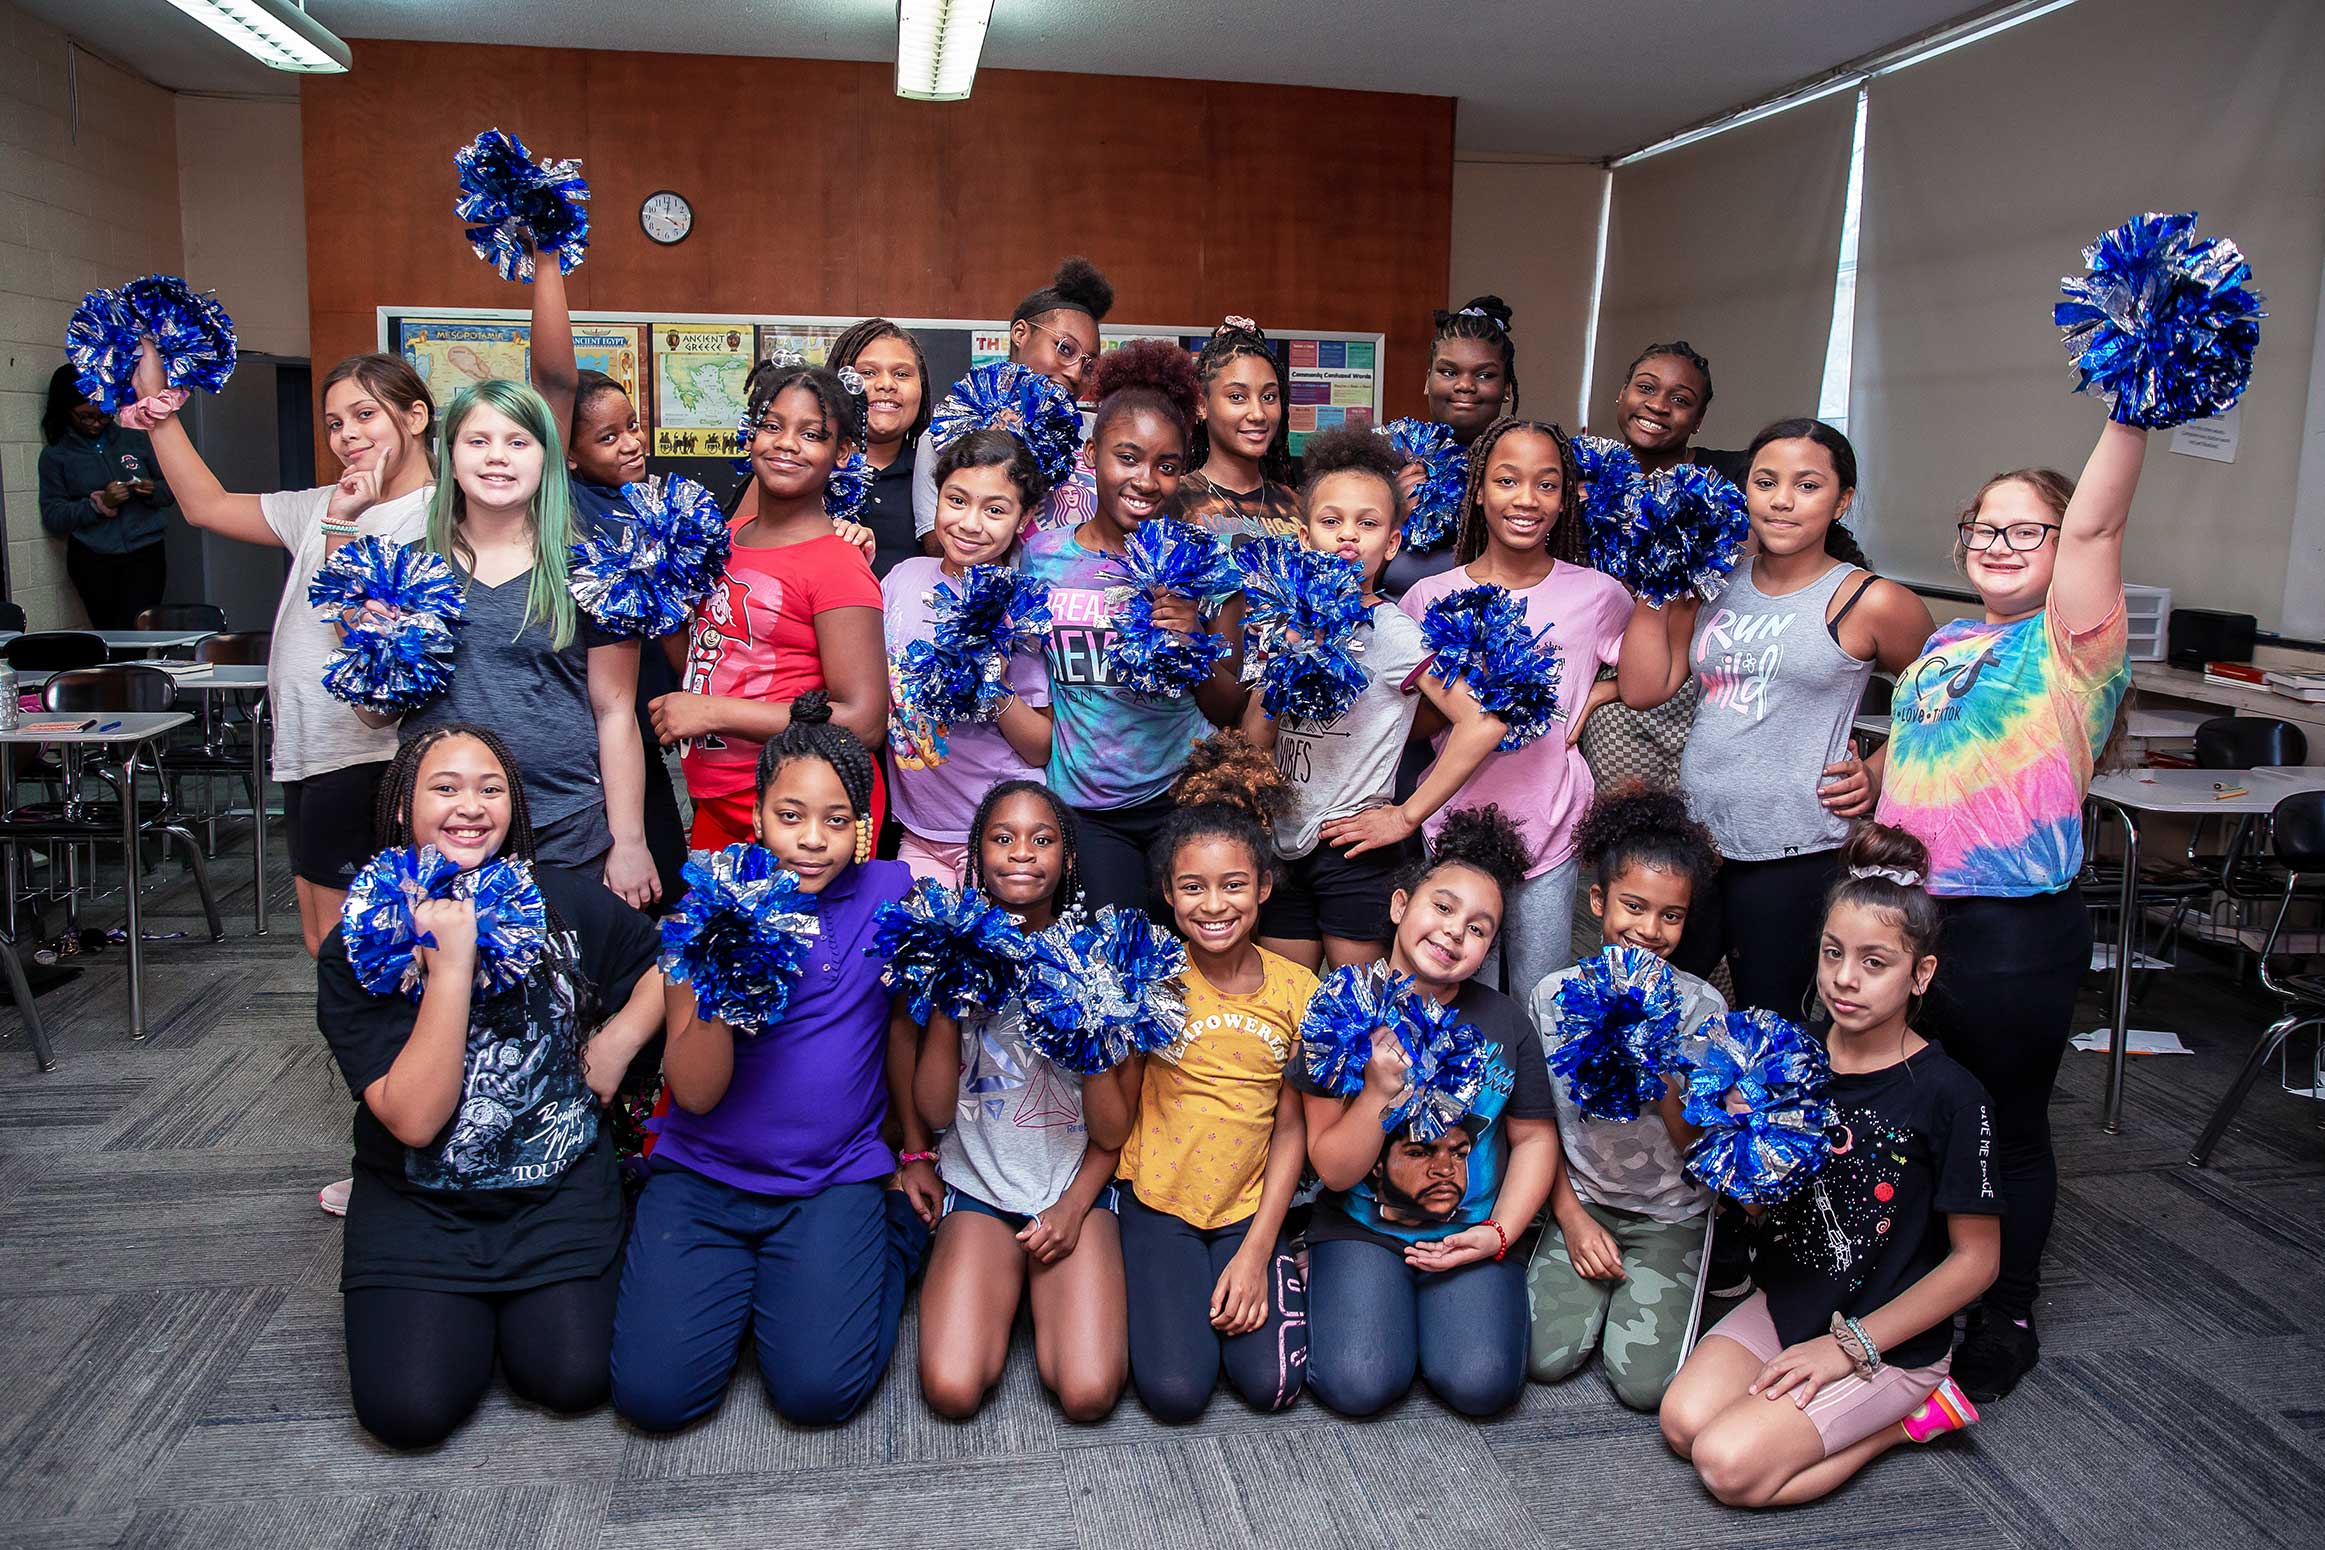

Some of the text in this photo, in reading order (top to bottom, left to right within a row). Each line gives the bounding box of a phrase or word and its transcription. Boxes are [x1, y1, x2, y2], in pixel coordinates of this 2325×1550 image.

[436, 330, 504, 341] MESOPOTAMIA
[602, 337, 625, 345] EGYPT
[682, 334, 725, 343] ANCIENT
[684, 343, 722, 351] GREECE
[1291, 371, 1323, 380] Commonly
[1048, 593, 1122, 621] REA
[1044, 629, 1118, 683] NEV
[1279, 736, 1312, 783] VIBES
[1173, 1013, 1288, 1061] EMPOWERED
[1066, 1123, 1089, 1134] Reeb
[1979, 1140, 1991, 1157] ME
[512, 1160, 567, 1181] TOUR
